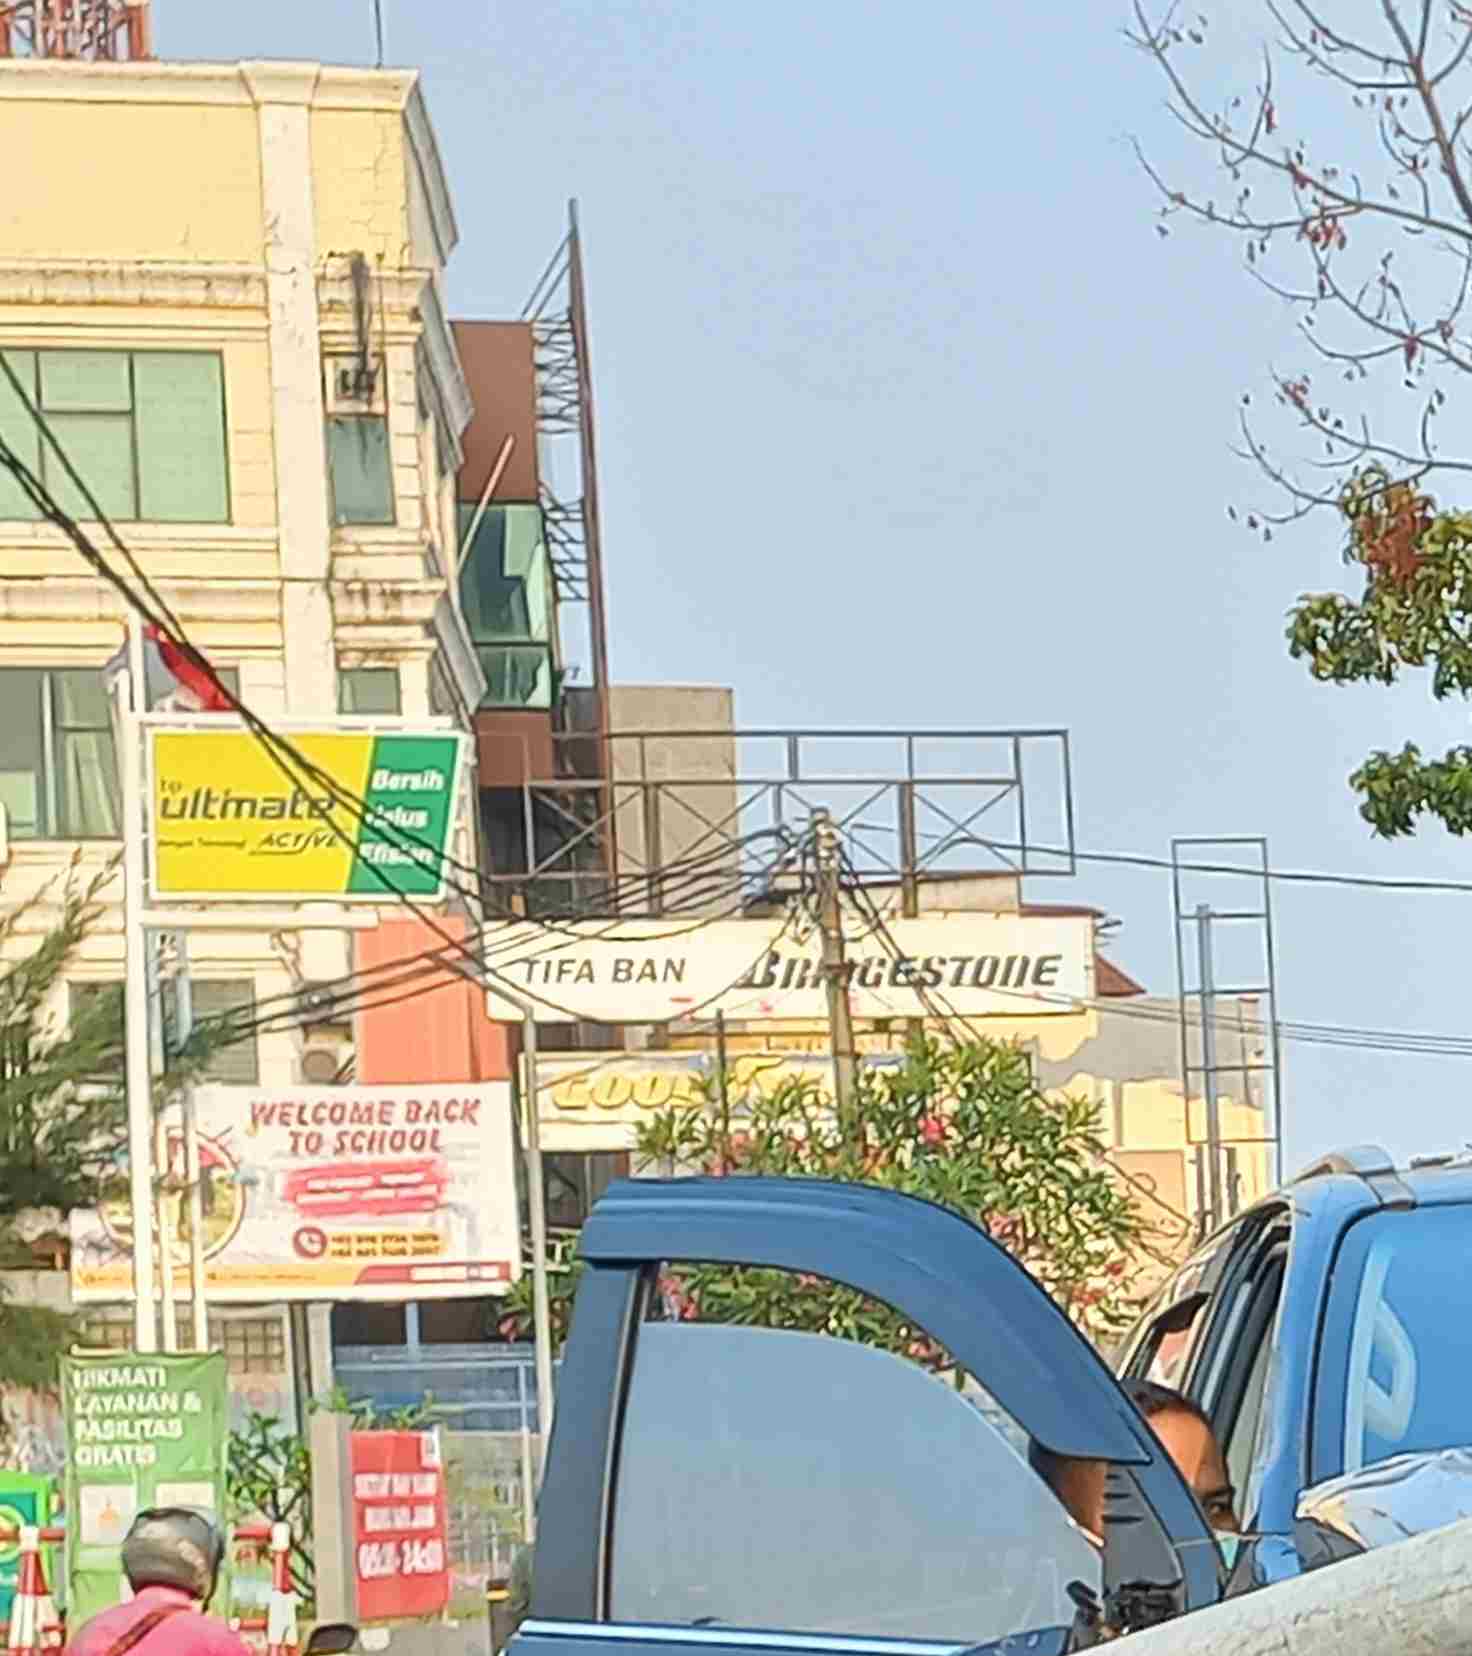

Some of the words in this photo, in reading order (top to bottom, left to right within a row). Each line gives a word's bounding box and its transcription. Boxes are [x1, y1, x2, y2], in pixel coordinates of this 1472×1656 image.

[520, 958, 595, 984] TIFA
[611, 957, 687, 983] BAN
[249, 1101, 396, 1127] WELCOME
[404, 1098, 482, 1126] BACK
[288, 1130, 323, 1155] TO
[332, 1128, 443, 1154] SCHOOL
[74, 1391, 179, 1414] LAYANAN
[74, 1444, 157, 1466] GRATIS
